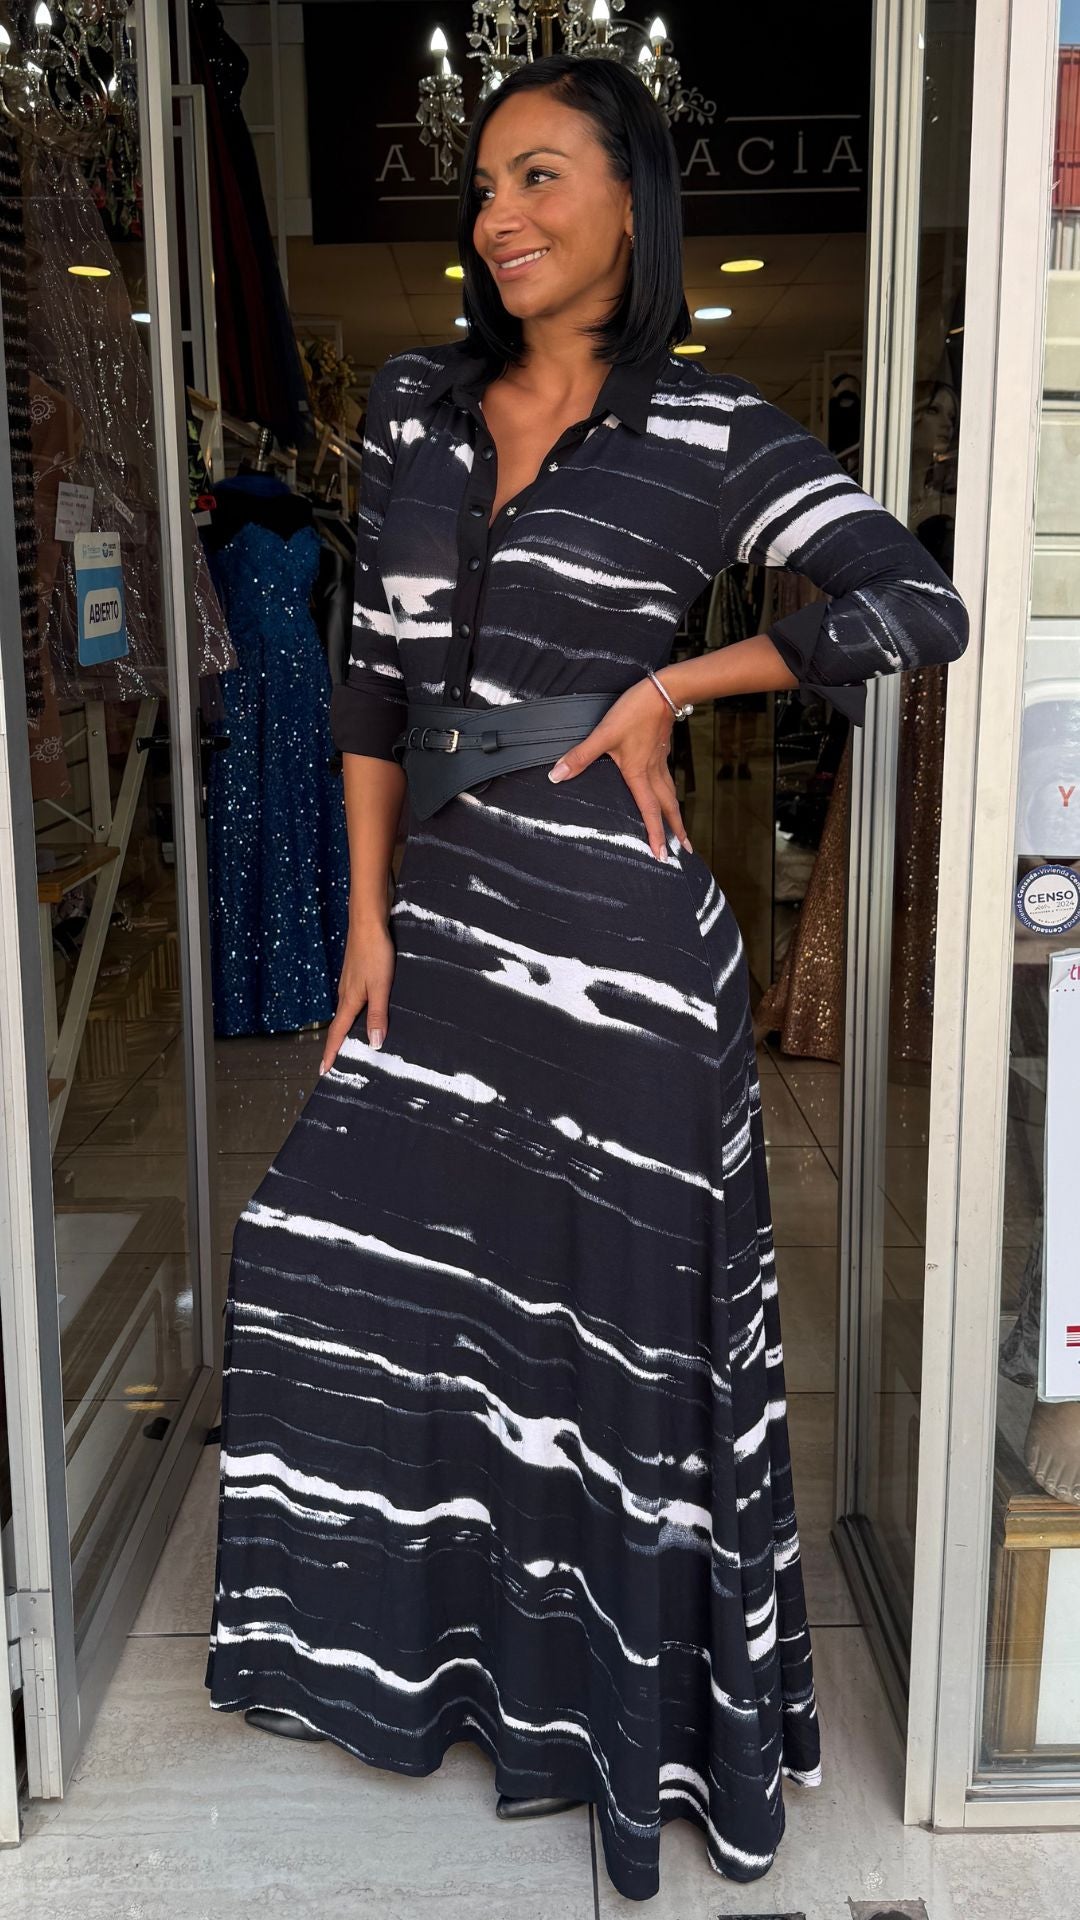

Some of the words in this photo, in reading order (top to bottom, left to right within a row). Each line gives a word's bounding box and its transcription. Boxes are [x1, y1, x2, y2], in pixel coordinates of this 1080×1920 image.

[89, 600, 119, 625] ABIERTO
[1039, 867, 1070, 877] Vivienda
[1027, 890, 1074, 904] CENSO
[1032, 925, 1063, 934] Censada
